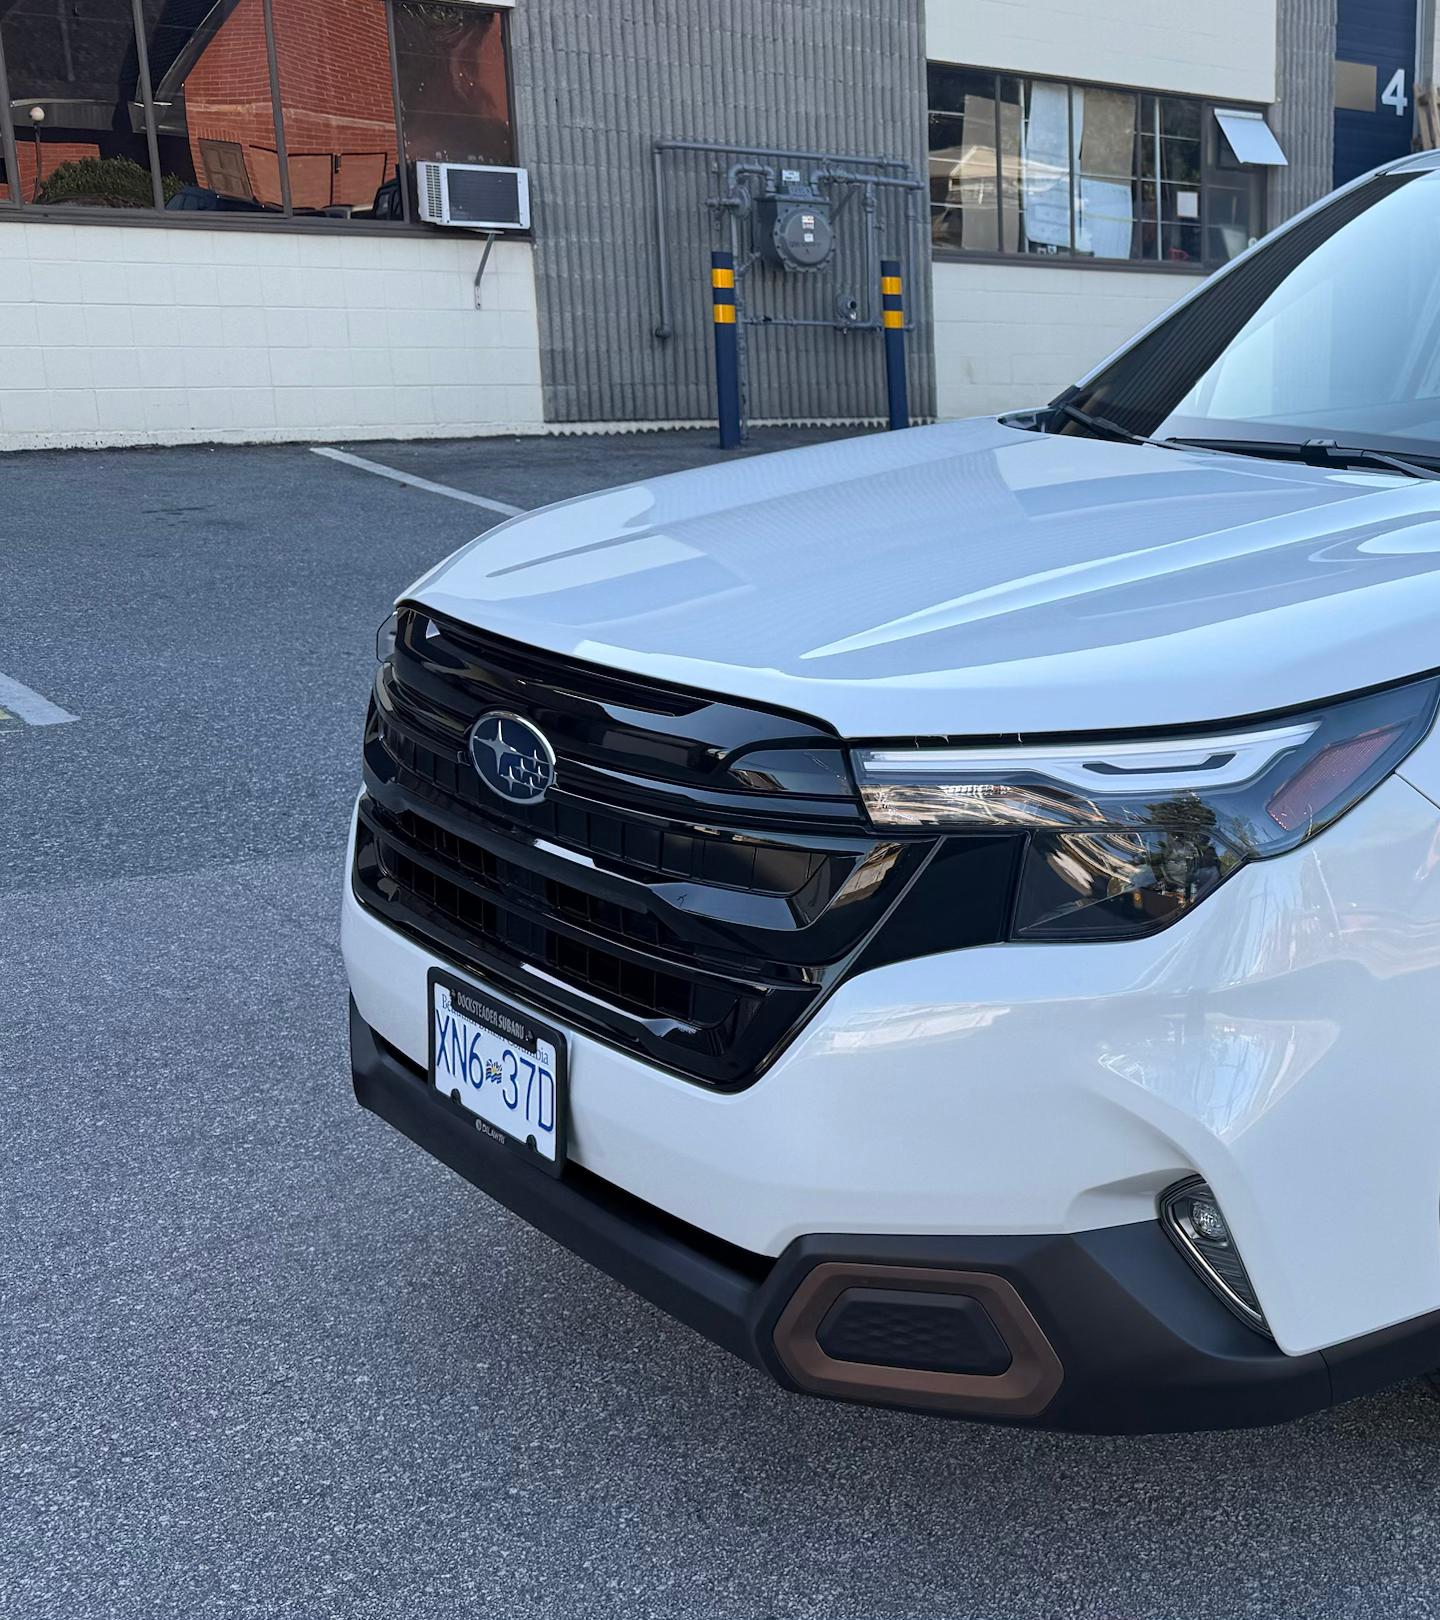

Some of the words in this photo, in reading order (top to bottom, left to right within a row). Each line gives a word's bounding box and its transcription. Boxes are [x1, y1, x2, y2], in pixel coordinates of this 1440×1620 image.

[1381, 69, 1408, 116] 4
[499, 1014, 525, 1040] SUBARU
[436, 1009, 484, 1089] XN6
[502, 1049, 554, 1132] 37D
